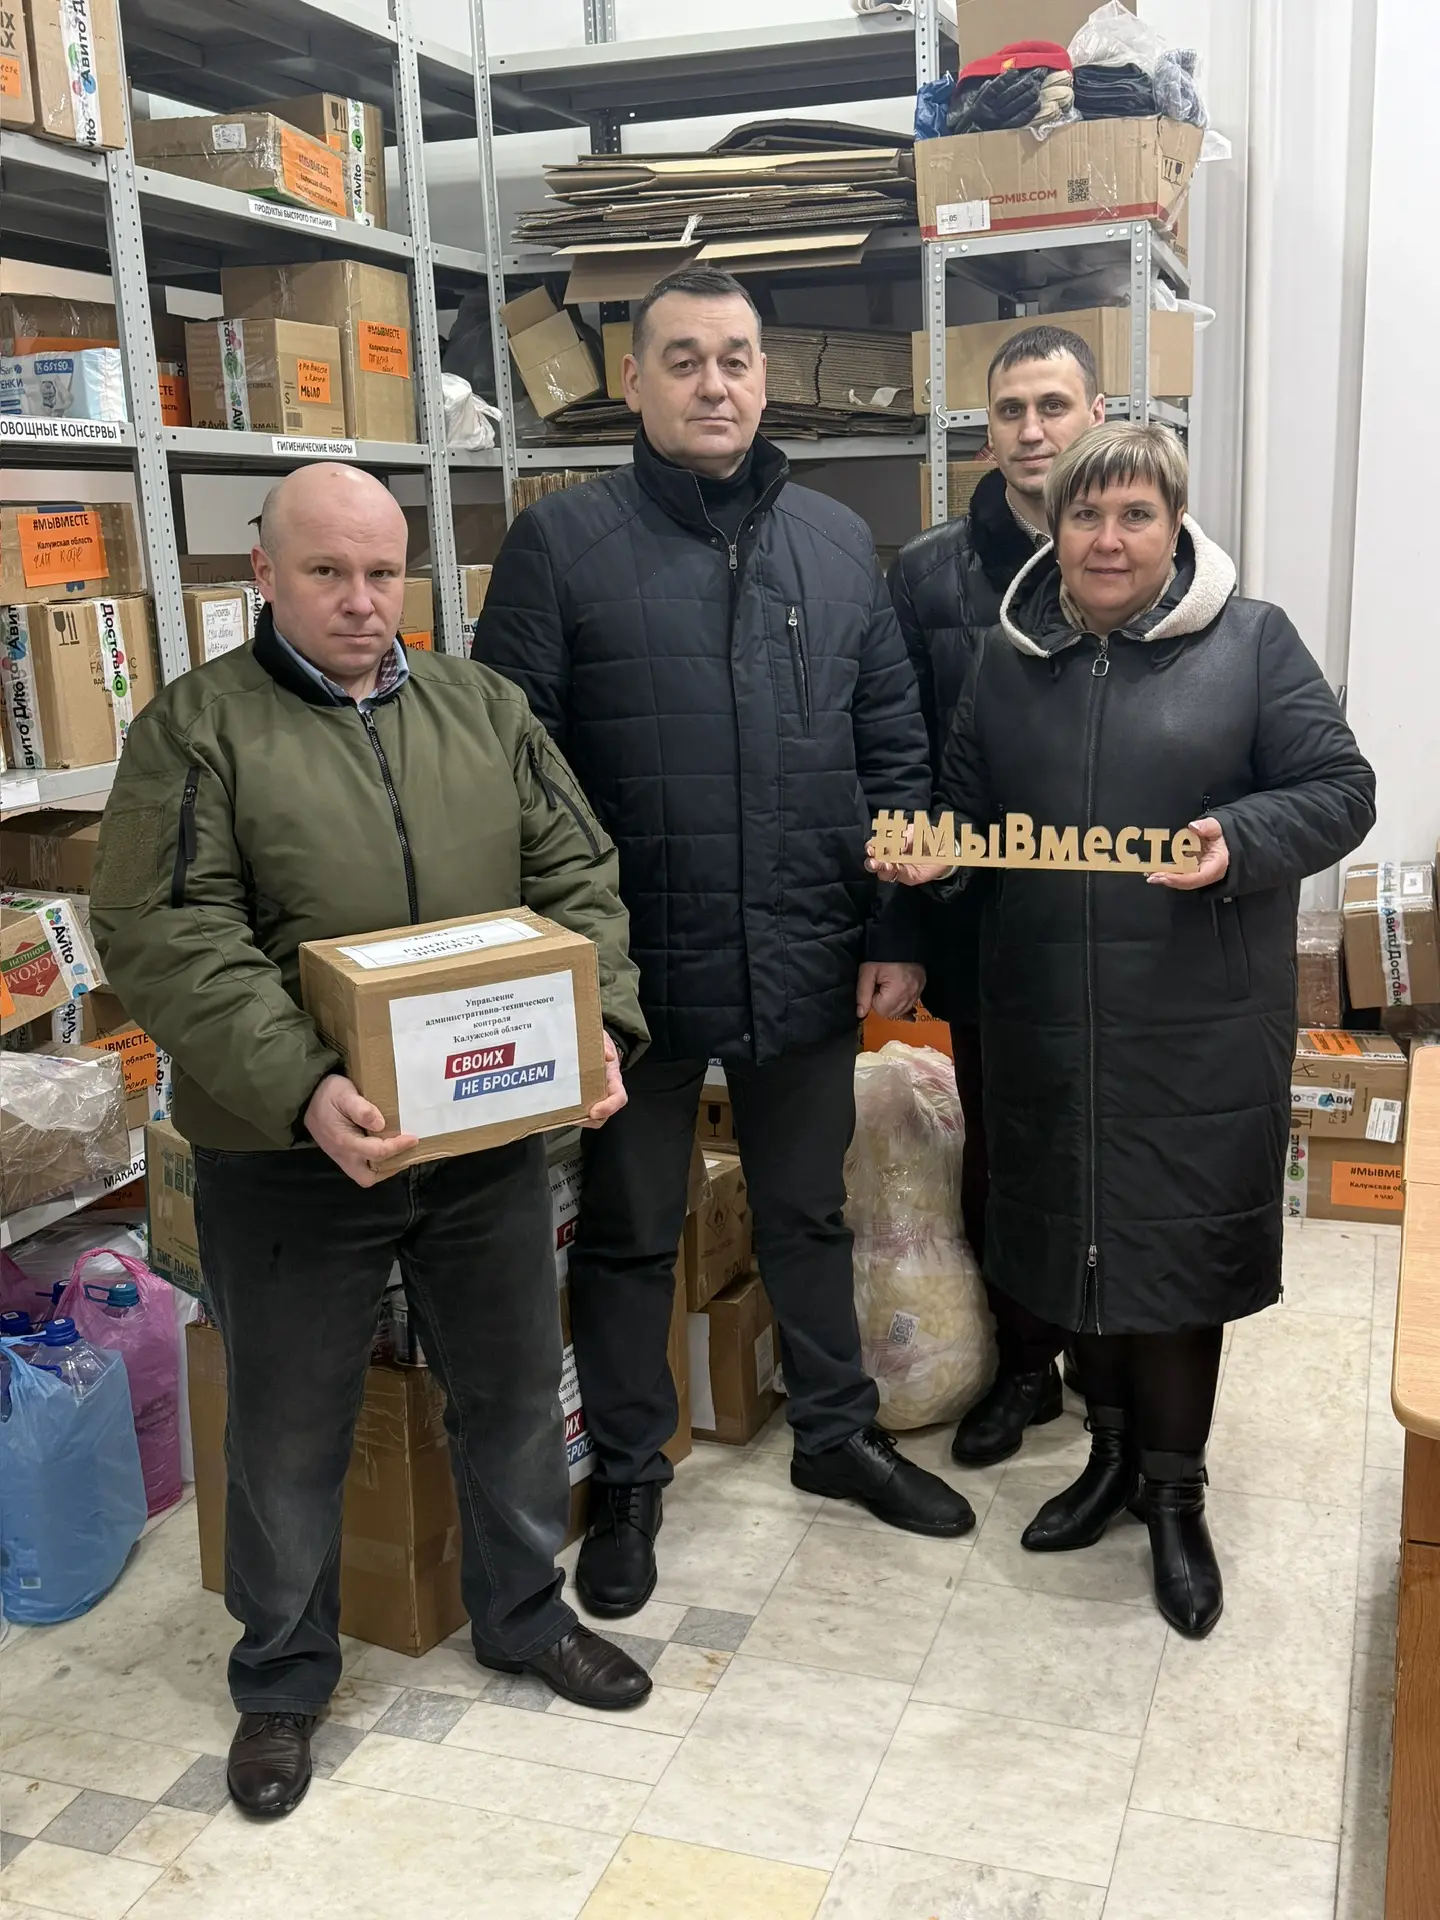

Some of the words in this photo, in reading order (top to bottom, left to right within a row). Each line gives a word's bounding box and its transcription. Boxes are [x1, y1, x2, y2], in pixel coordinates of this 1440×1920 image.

[353, 164, 362, 199] Avito
[254, 203, 283, 217] ПРОДУКТЫ
[283, 209, 309, 223] БЫСТРОГО
[309, 215, 333, 228] ПИТАНИЯ
[1, 378, 24, 389] ЕНКИ
[0, 421, 59, 438] ОВОЩНЫЕ
[61, 423, 117, 439] КОНСЕРВЫ
[277, 441, 328, 453] ГИГИЕНИЧЕСКИЕ
[329, 444, 353, 454] НАБОРЫ
[33, 514, 89, 531] #МЫВМЕСТЕ
[37, 540, 70, 550] Калужская
[71, 536, 93, 546] область
[101, 603, 124, 691] Доставка
[871, 809, 1202, 867] #МыВместе
[1381, 906, 1400, 948] Авито
[52, 926, 74, 964] Avito
[9, 945, 45, 967] КОНЦЕРН
[465, 993, 515, 1008] Управление
[425, 996, 554, 1027] административно-технического
[473, 1015, 512, 1029] контроля
[453, 1029, 500, 1043] Калужской
[501, 1022, 532, 1034] области
[125, 1051, 155, 1066] область
[452, 1049, 504, 1074] СВОИХ
[461, 1079, 479, 1096] НЕ
[483, 1065, 548, 1091] БРОСАЕМ
[1325, 1093, 1353, 1104] Ави
[104, 1159, 147, 1189] МАКАРО
[1350, 1167, 1401, 1179] #МЫВМЕ
[1350, 1181, 1391, 1191] Калужская
